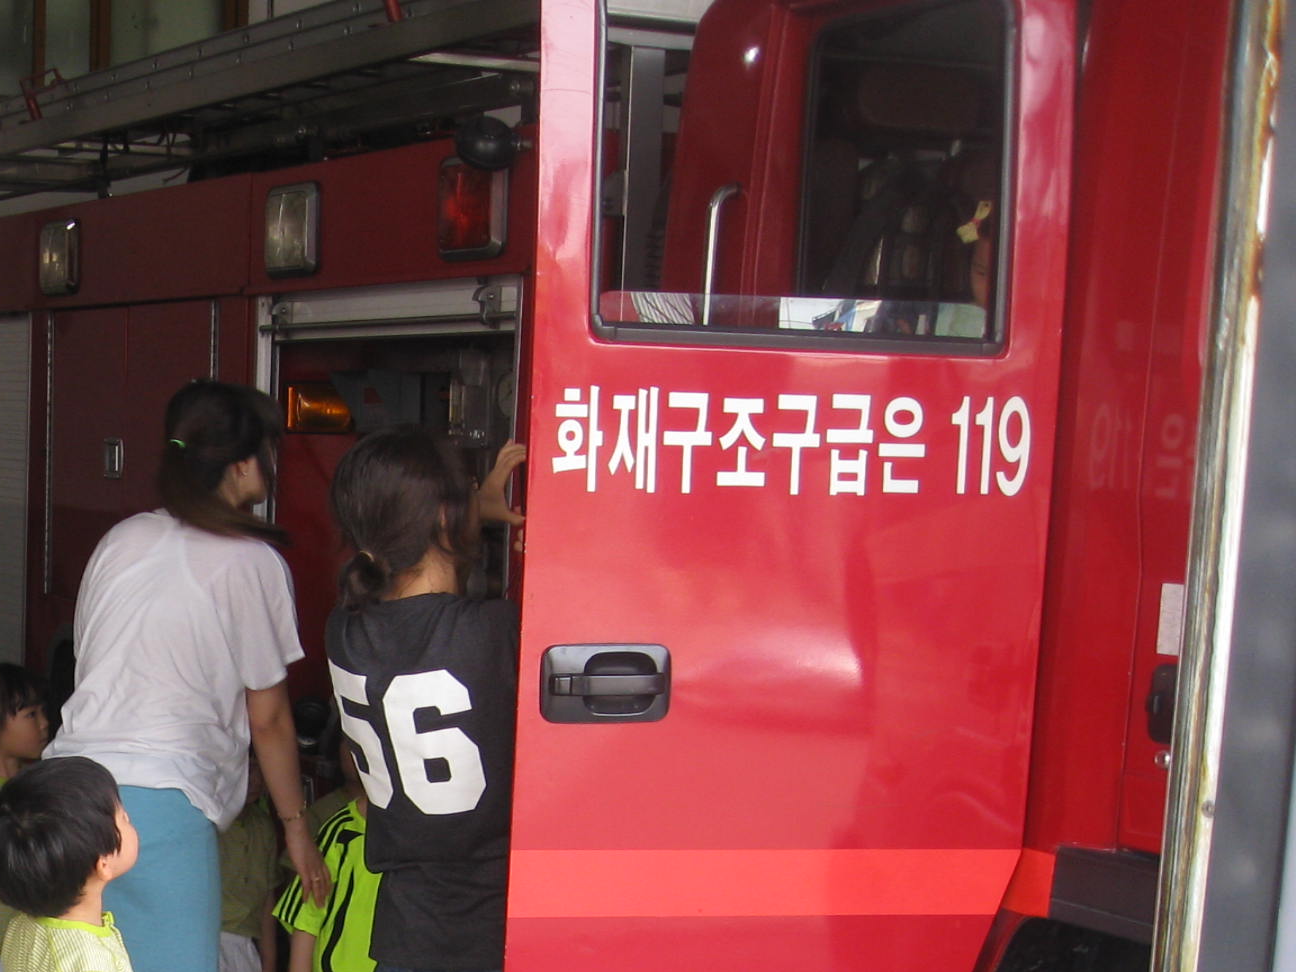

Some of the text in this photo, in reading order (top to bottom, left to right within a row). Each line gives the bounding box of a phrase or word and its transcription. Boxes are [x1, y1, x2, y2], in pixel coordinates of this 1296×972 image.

[551, 384, 926, 496] 화재구조구급은
[950, 395, 1032, 497] 119
[327, 657, 487, 815] 56
